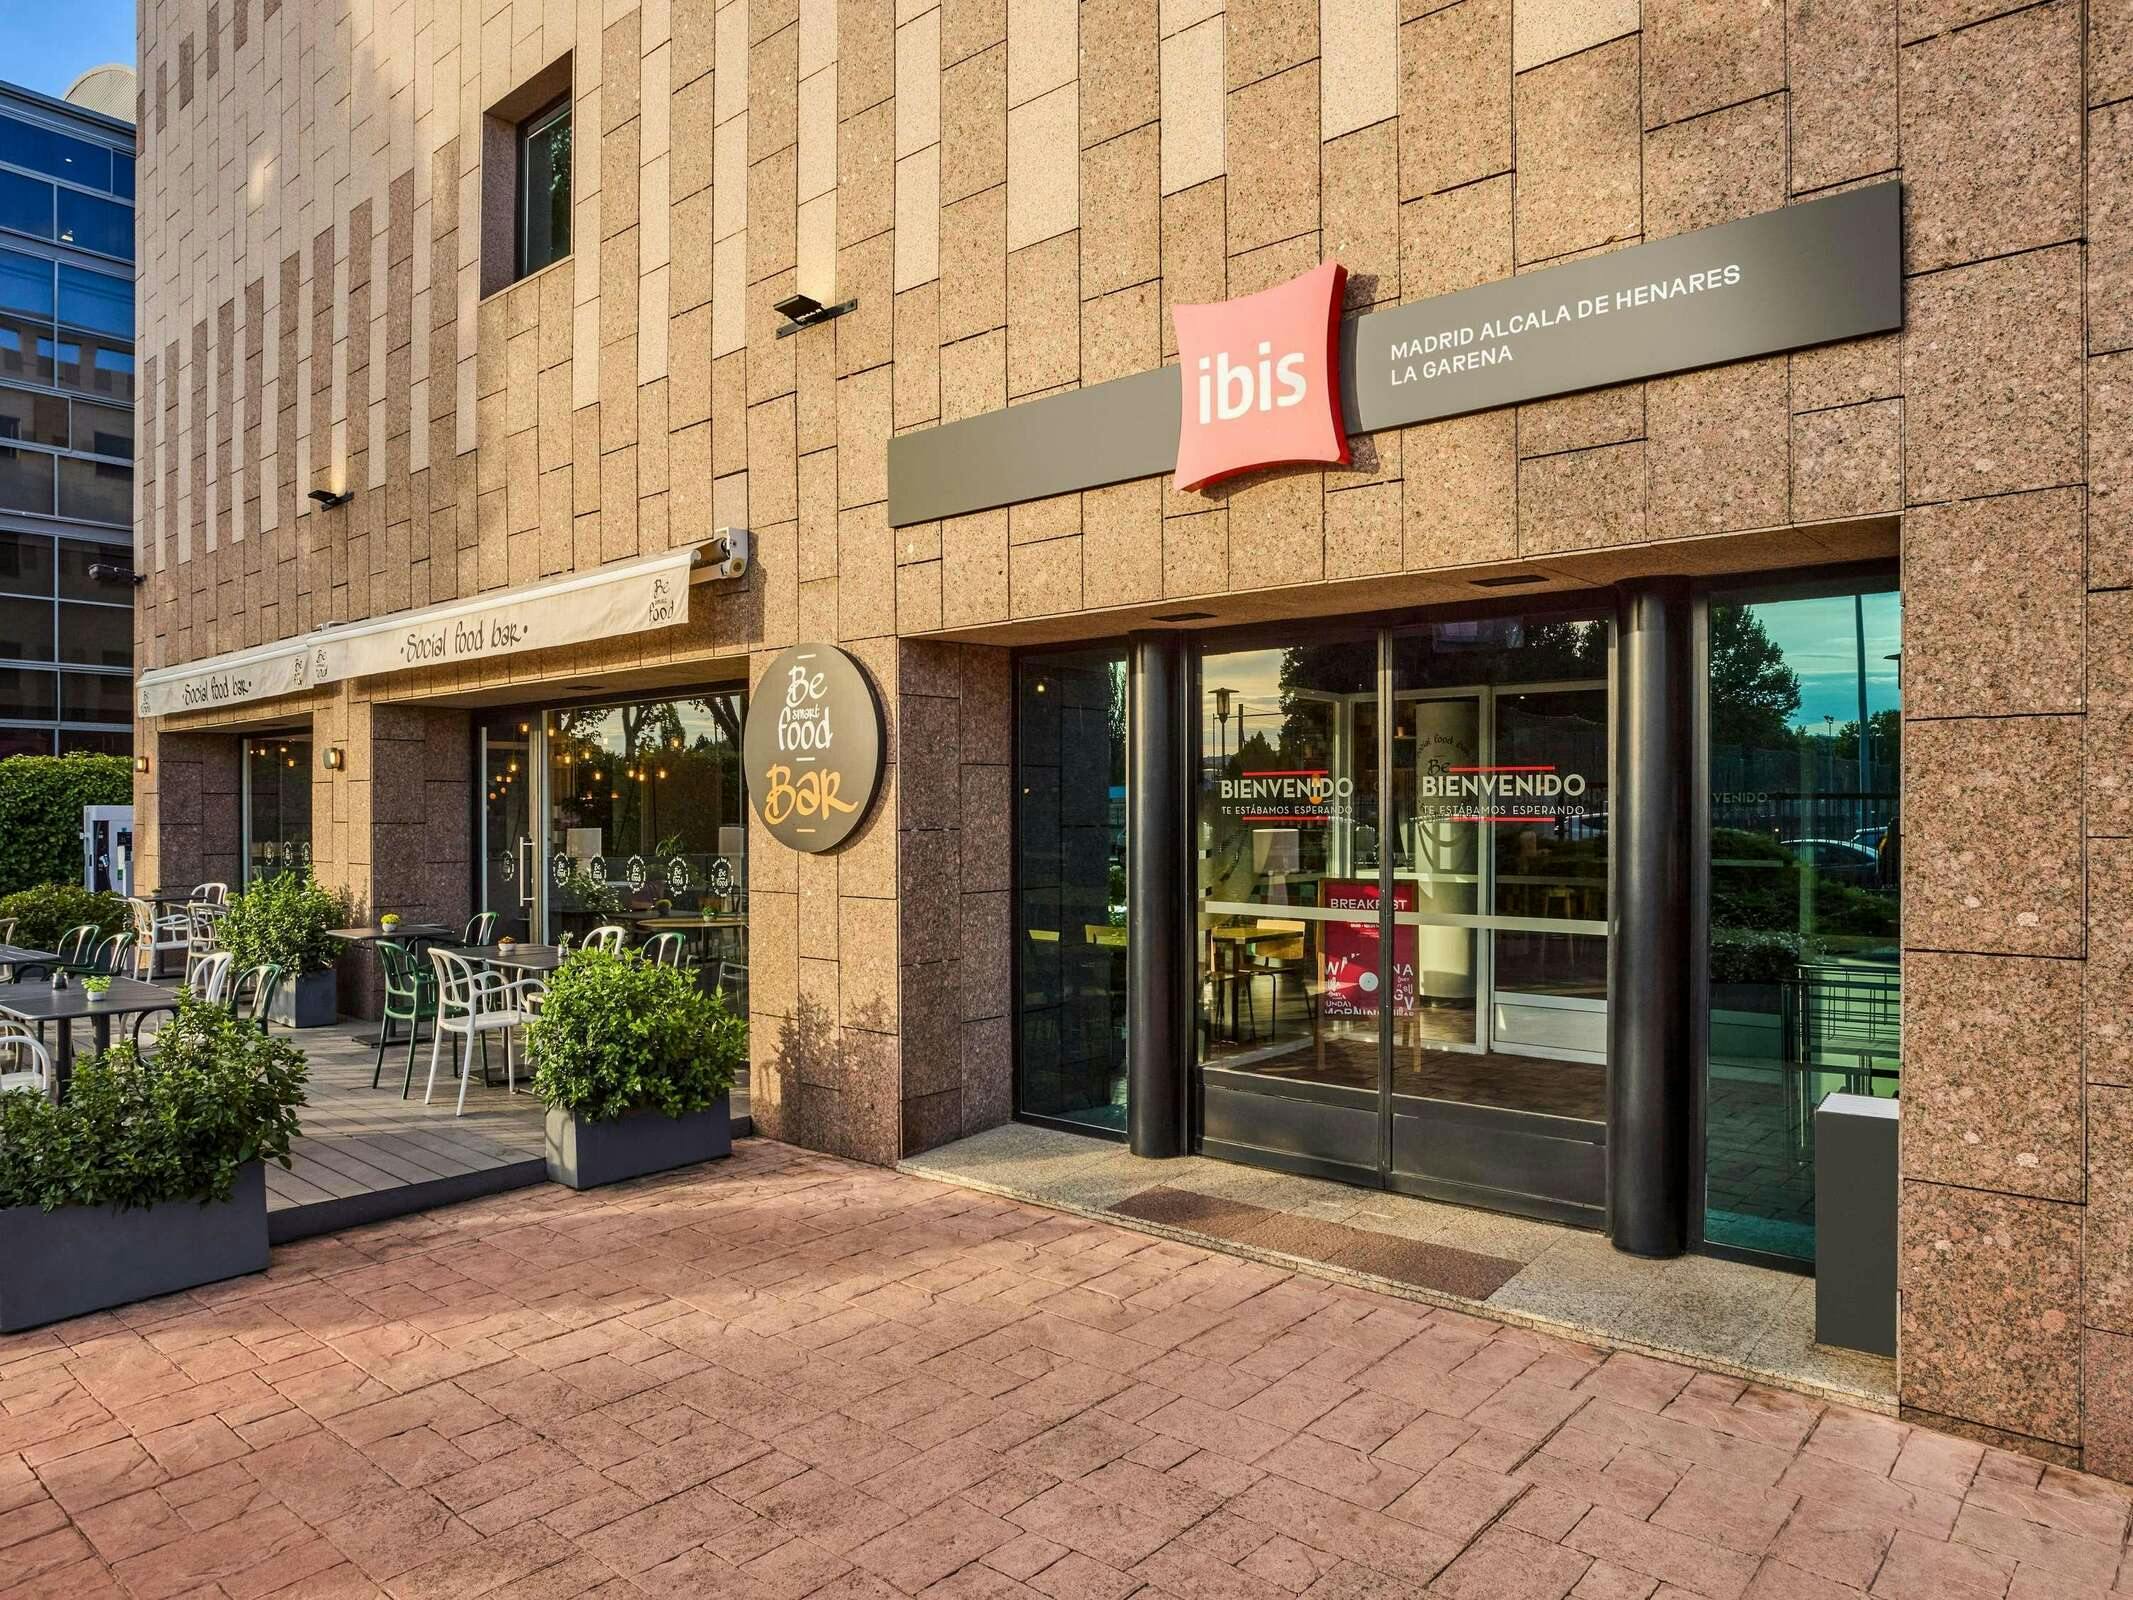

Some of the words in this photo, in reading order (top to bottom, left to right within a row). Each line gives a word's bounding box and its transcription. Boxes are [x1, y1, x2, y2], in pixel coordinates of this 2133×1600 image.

[1391, 327, 1474, 361] MADRID
[1479, 304, 1571, 341] ALCALA
[1577, 294, 1609, 319] DE
[1616, 264, 1741, 310] HENARES
[1199, 341, 1307, 424] ibis
[1391, 365, 1417, 386] LA
[1422, 345, 1513, 379] GARENA
[455, 619, 484, 654] food
[786, 665, 829, 708] Be
[778, 705, 834, 751] food
[1221, 777, 1354, 799] BIENVENIDO
[1422, 773, 1586, 797] BIENVENIDO
[1221, 806, 1232, 815] TE
[1235, 804, 1289, 815] ESTÁBAMOS
[1294, 805, 1353, 815] ESPERANDO
[1423, 805, 1434, 815] TE
[1440, 802, 1506, 815] ESTÁBAMOS
[1512, 805, 1585, 815] ESPERANDO
[1330, 898, 1408, 910] BREAKFST
